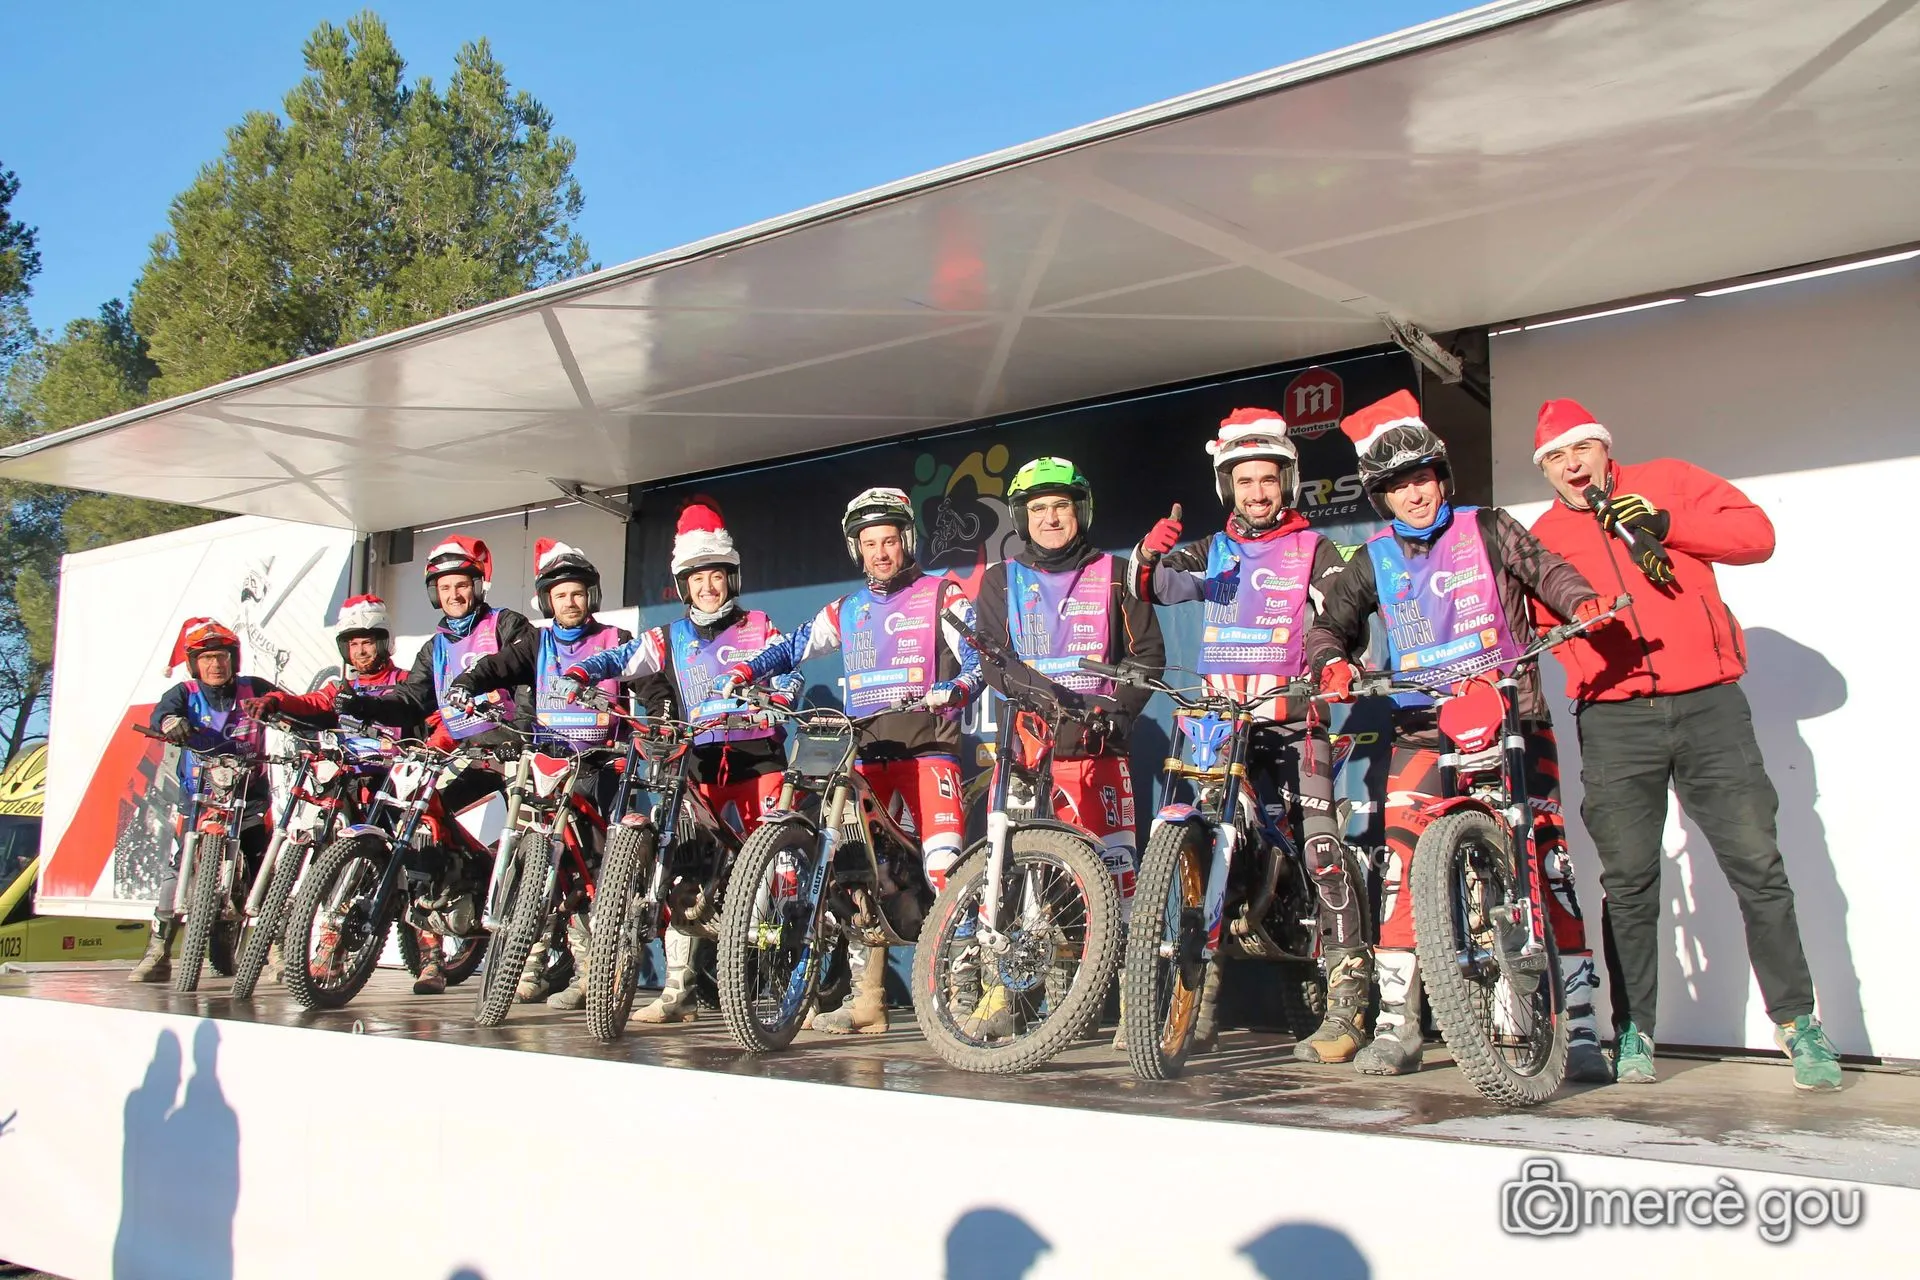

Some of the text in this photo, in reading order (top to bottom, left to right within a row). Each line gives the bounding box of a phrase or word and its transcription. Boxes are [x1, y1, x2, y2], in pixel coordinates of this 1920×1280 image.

[1290, 421, 1336, 435] Montesa
[1265, 597, 1288, 608] fcm
[1454, 594, 1480, 611] fcm
[1255, 615, 1293, 626] TrialGo
[1453, 612, 1495, 635] TrialGo
[1073, 622, 1094, 633] fcm
[1220, 631, 1231, 641] La
[897, 638, 917, 648] fcm
[1067, 641, 1104, 653] TrialGo
[1421, 652, 1434, 664] La
[1435, 639, 1477, 660] Marató
[891, 655, 926, 666] TrialGo
[862, 670, 904, 684] La Marató
[702, 705, 712, 713] La
[551, 714, 593, 724] La Marató
[812, 865, 824, 895] GALFER
